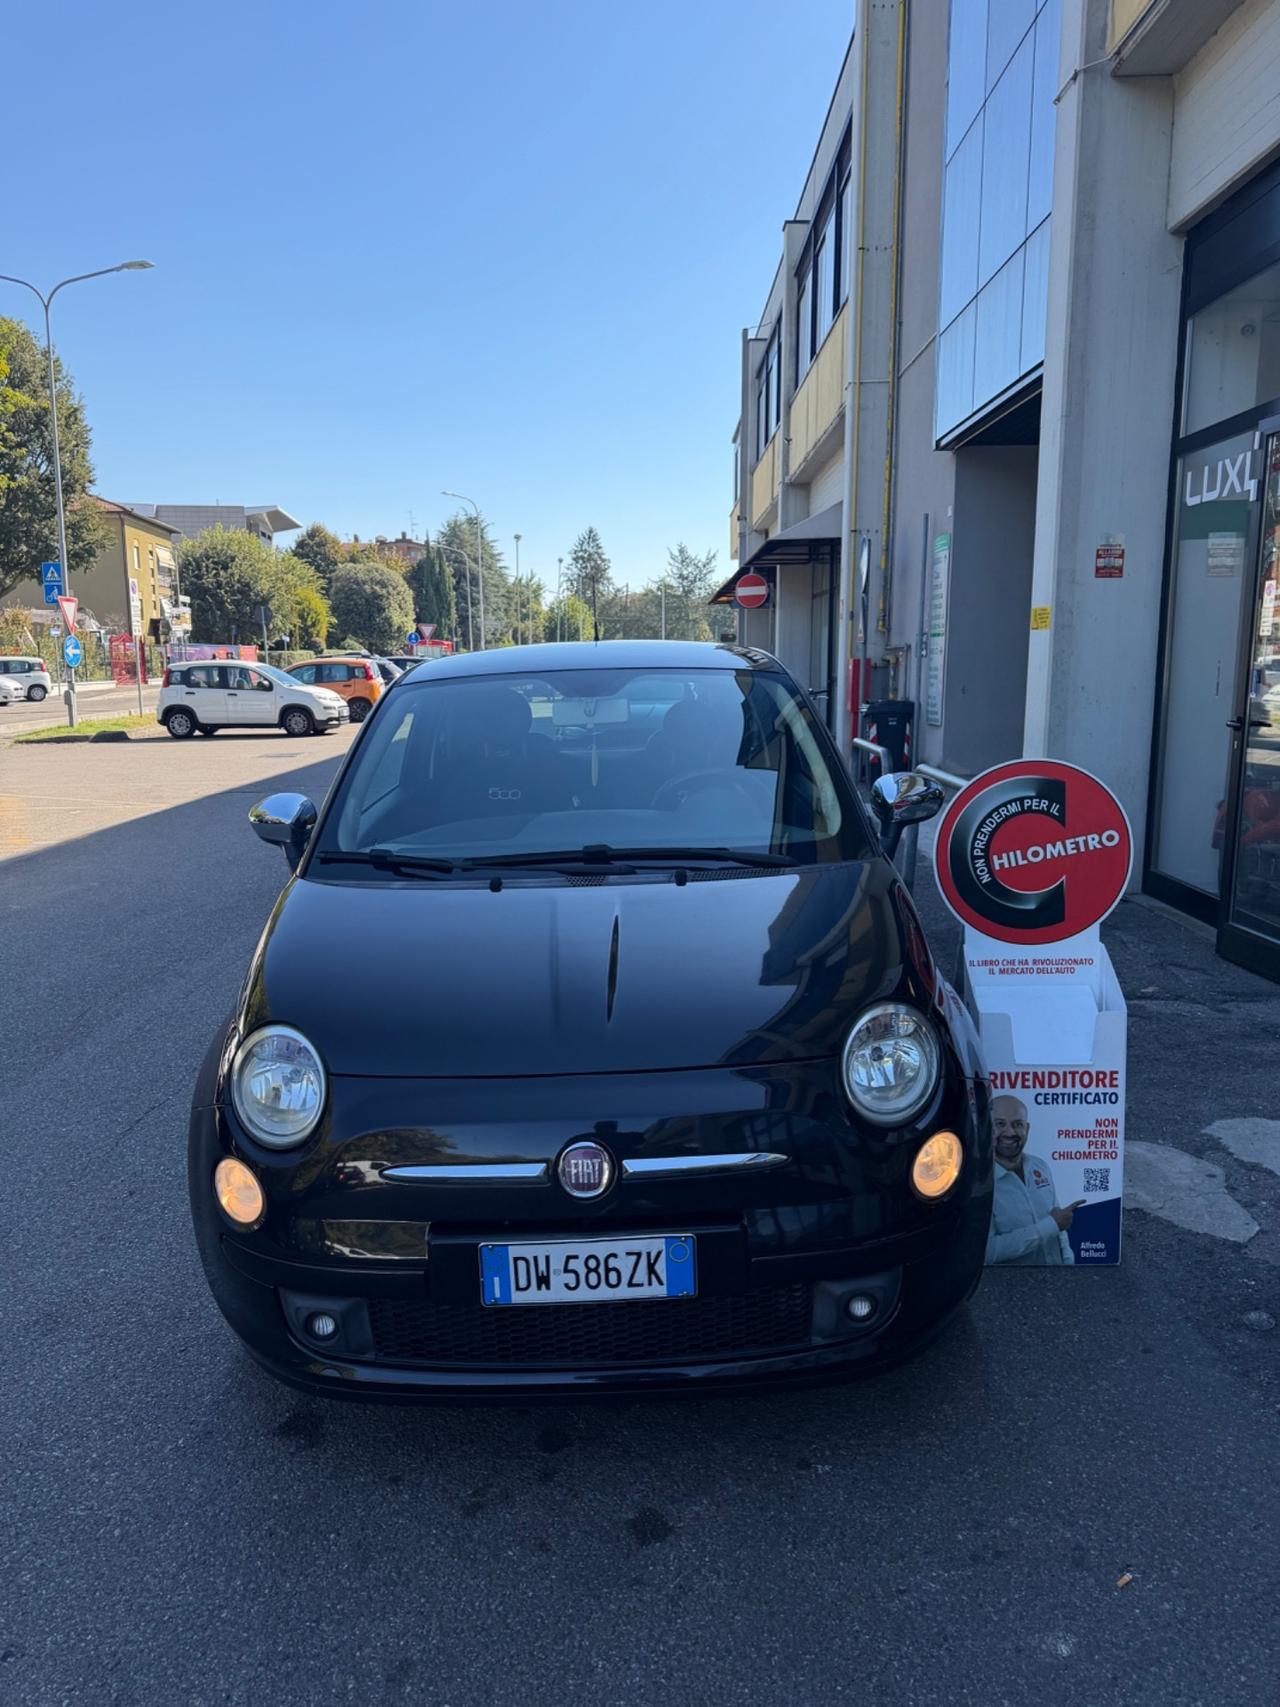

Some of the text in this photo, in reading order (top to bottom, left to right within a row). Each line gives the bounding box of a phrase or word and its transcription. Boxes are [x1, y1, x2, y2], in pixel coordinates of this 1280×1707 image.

[488, 787, 522, 800] 500
[973, 799, 1061, 885] NON PRENDERMI PER IL
[969, 958, 1094, 967] IL LIBRO CHE HA RIVOLUZIONATO
[988, 967, 1076, 975] IL MERCATO DELL'AUTO
[988, 1070, 1119, 1089] RIVENDITORE
[1034, 1092, 1119, 1105] CERTIFICATO
[1095, 1118, 1118, 1128] NON
[1057, 1129, 1118, 1139] PRENDERMI
[1088, 1140, 1119, 1149] PER IL
[1051, 1150, 1118, 1160] CHILOMETRO
[570, 1158, 601, 1184] FIAT
[1080, 1241, 1105, 1250] Alfredo
[1080, 1250, 1107, 1258] Bellucci
